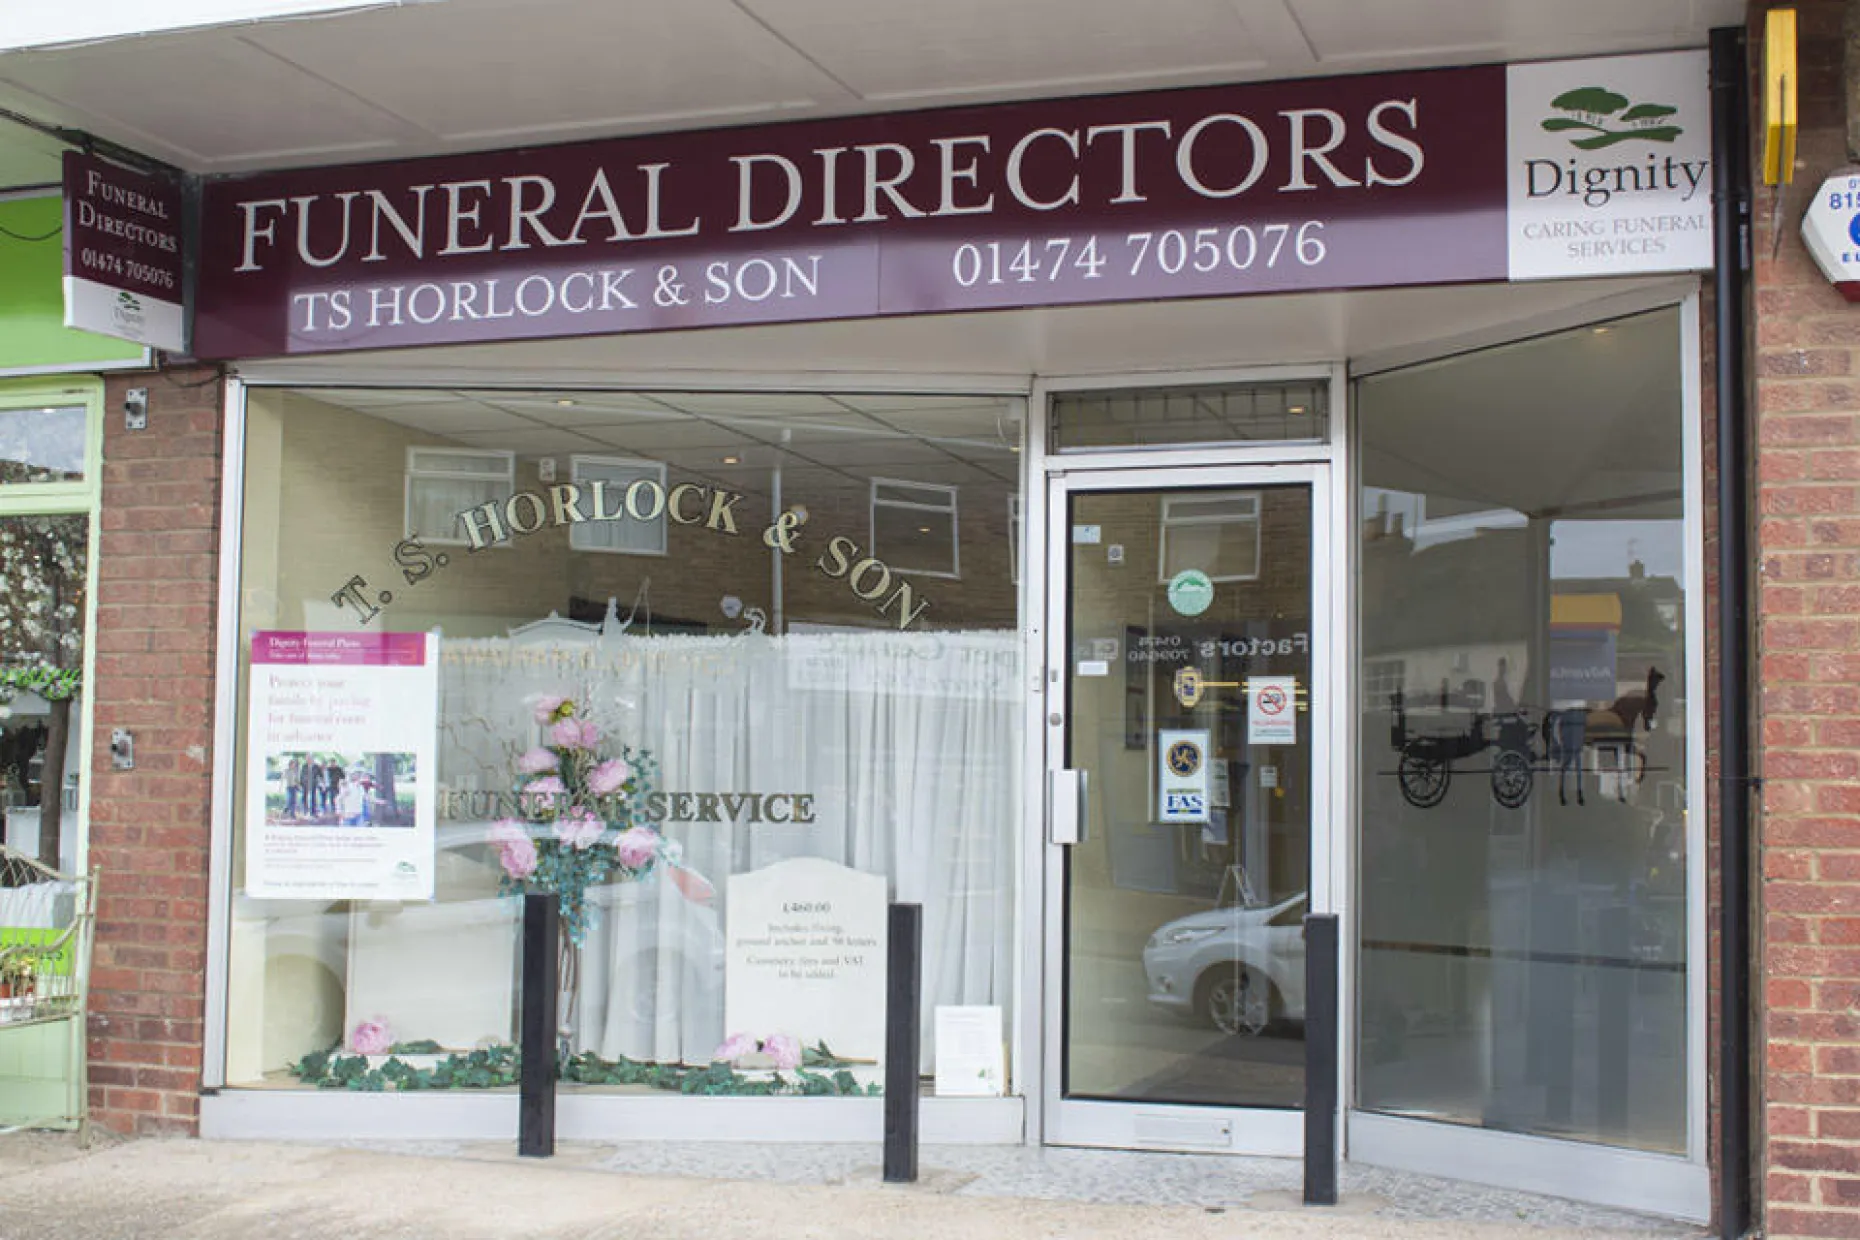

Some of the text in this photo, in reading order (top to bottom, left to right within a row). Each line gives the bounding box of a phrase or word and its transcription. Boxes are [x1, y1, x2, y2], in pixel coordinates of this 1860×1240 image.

[88, 169, 168, 219] FUNERAL
[234, 98, 1425, 273] FUNERAL DIRECTORS
[1524, 153, 1709, 207] Dignity
[78, 200, 177, 252] DIRECTORS
[1523, 214, 1705, 240] CARING FUNERAL
[1567, 236, 1667, 259] SERVICES
[81, 247, 173, 289] 01474 705076
[951, 220, 1326, 287] 01474 705076
[294, 254, 823, 332] TS HORLOCK & SON
[331, 478, 930, 631] T. S. HORLOCK & SON
[644, 791, 815, 824] SERVICE
